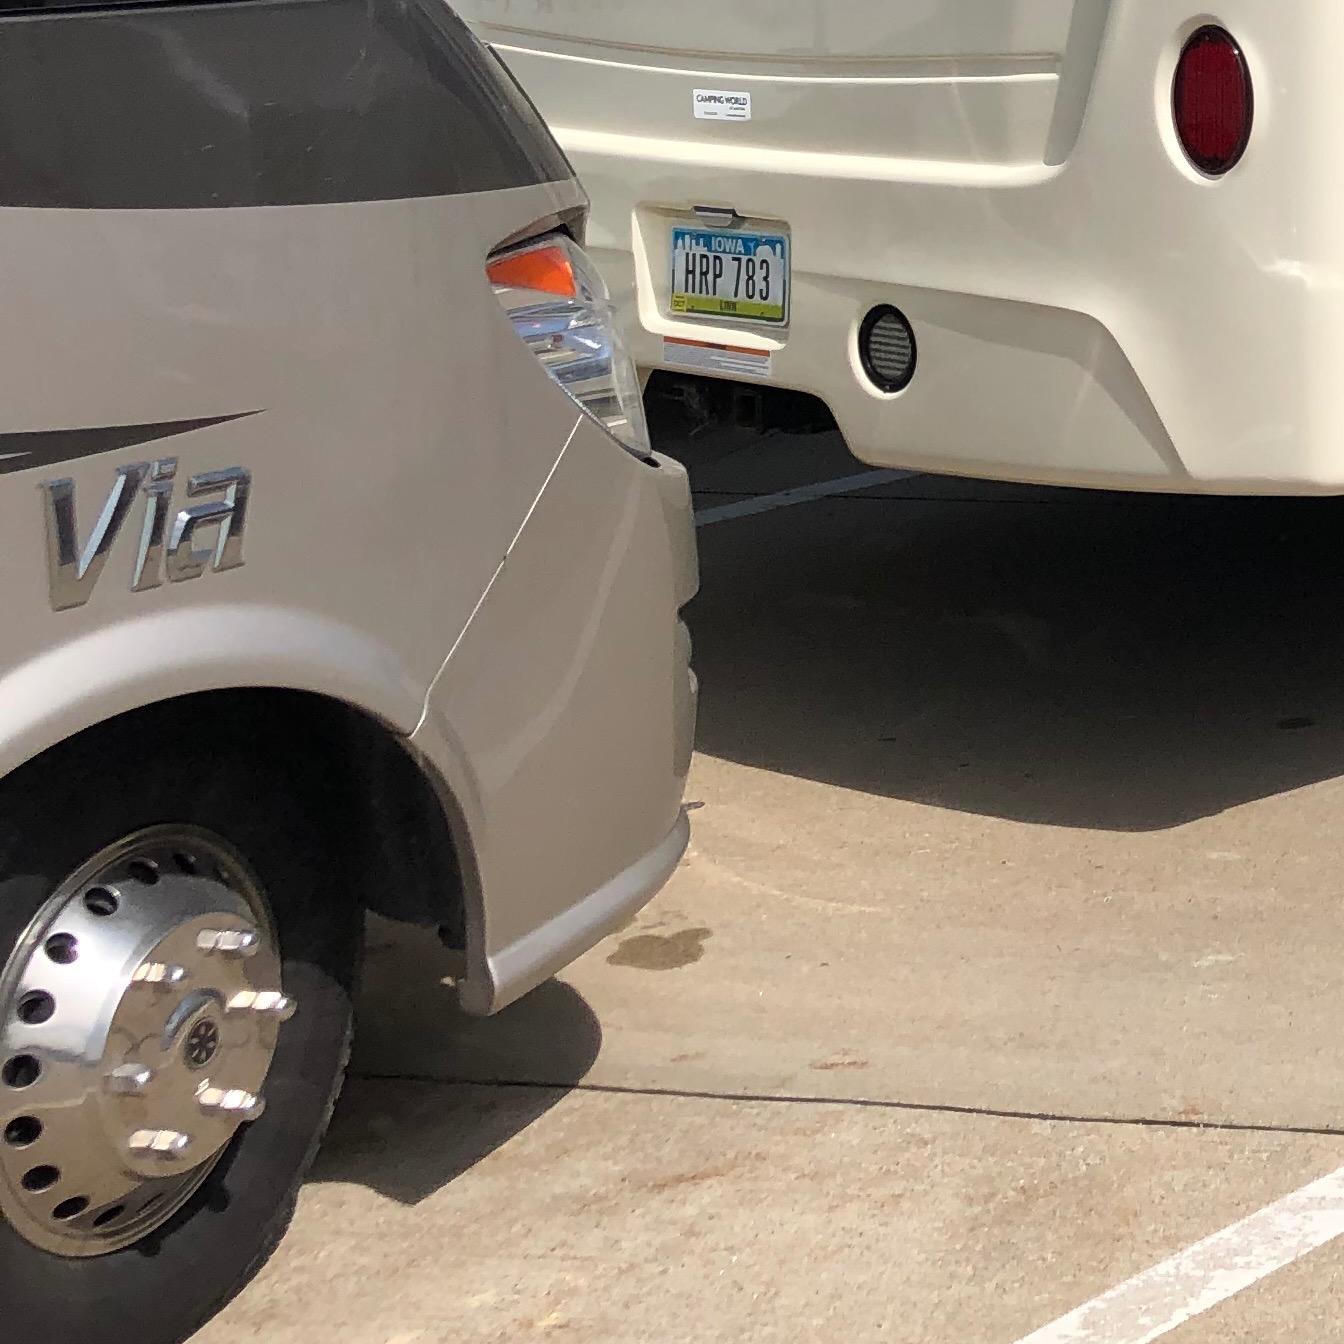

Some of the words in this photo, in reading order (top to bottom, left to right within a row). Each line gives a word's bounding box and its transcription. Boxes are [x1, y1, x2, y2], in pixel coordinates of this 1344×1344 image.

[696, 93, 724, 105] CAMPING
[725, 95, 747, 106] WORLD
[711, 236, 745, 254] IOWA
[684, 252, 723, 296] HRP
[732, 256, 770, 301] 783
[39, 456, 252, 613] Via
